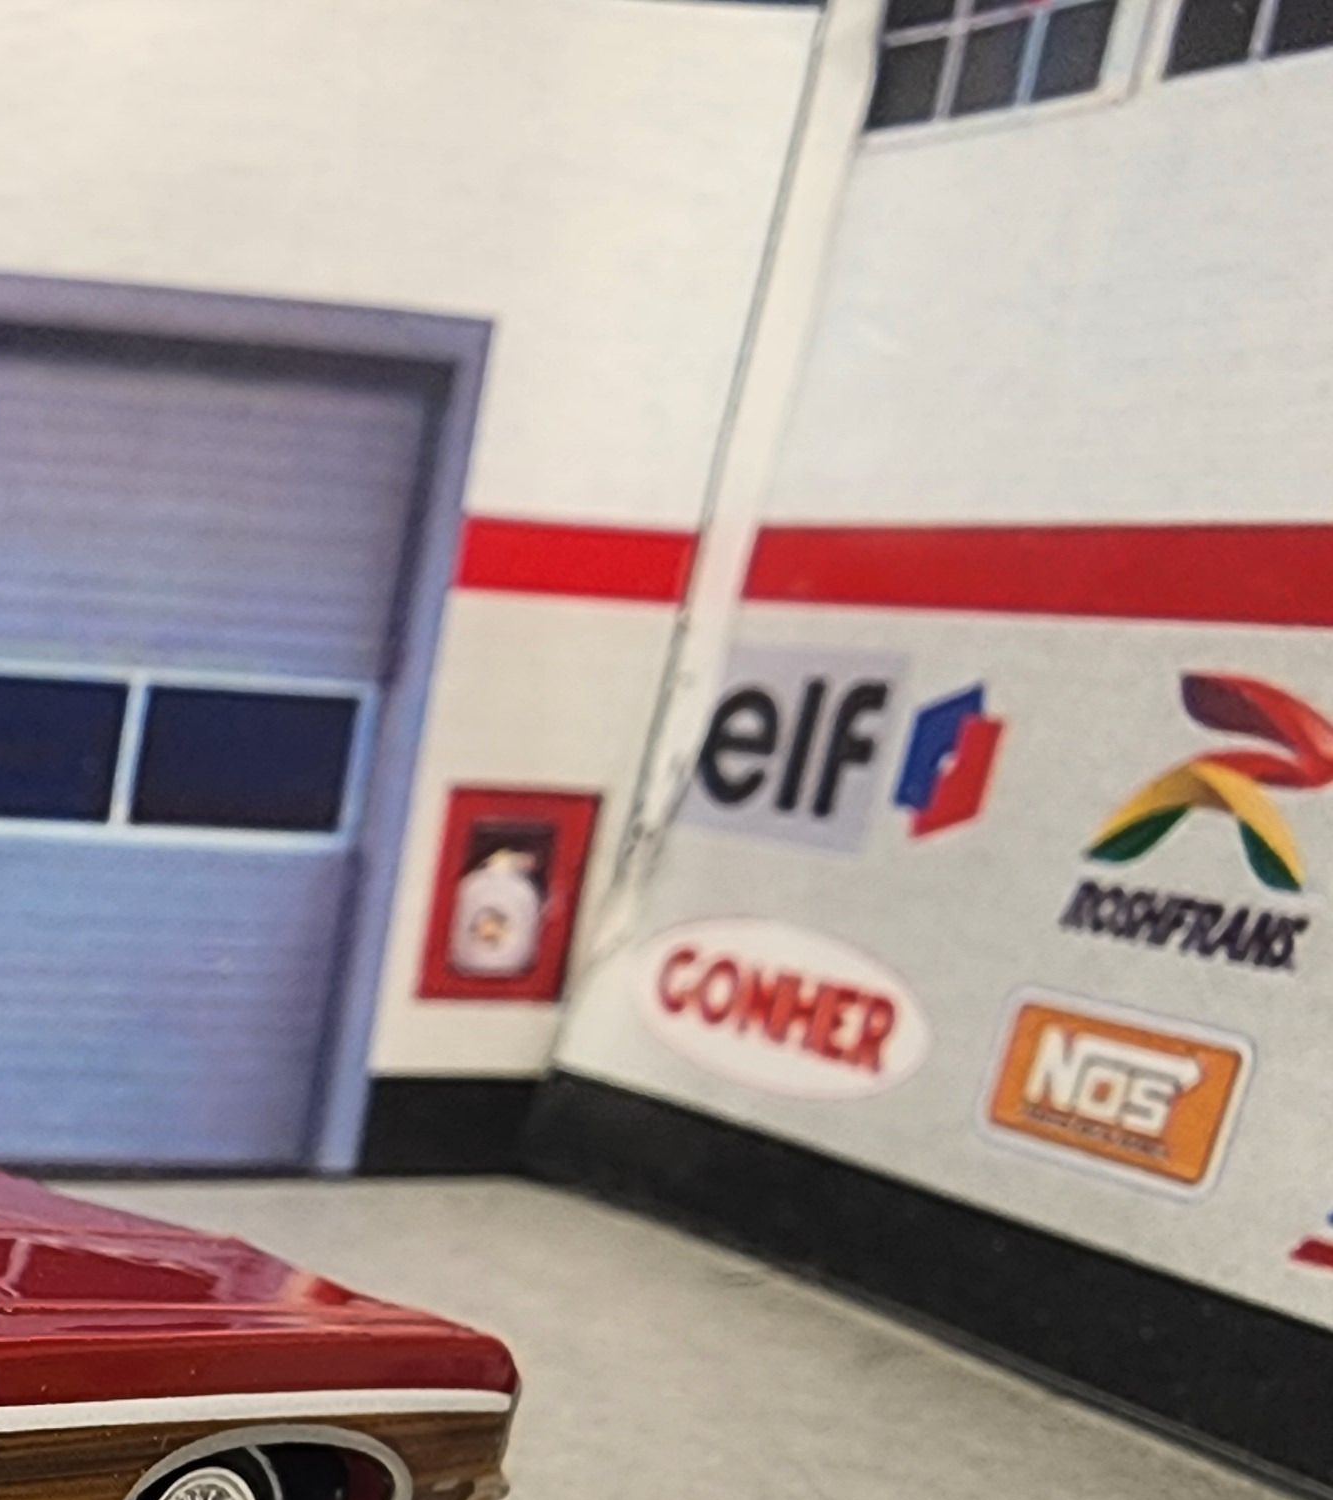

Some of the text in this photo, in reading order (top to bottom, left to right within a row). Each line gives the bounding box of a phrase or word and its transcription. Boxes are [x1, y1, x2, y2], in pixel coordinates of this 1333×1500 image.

[699, 677, 888, 818] elf
[657, 948, 896, 1074] CONHER
[1024, 1021, 1201, 1138] NOS
